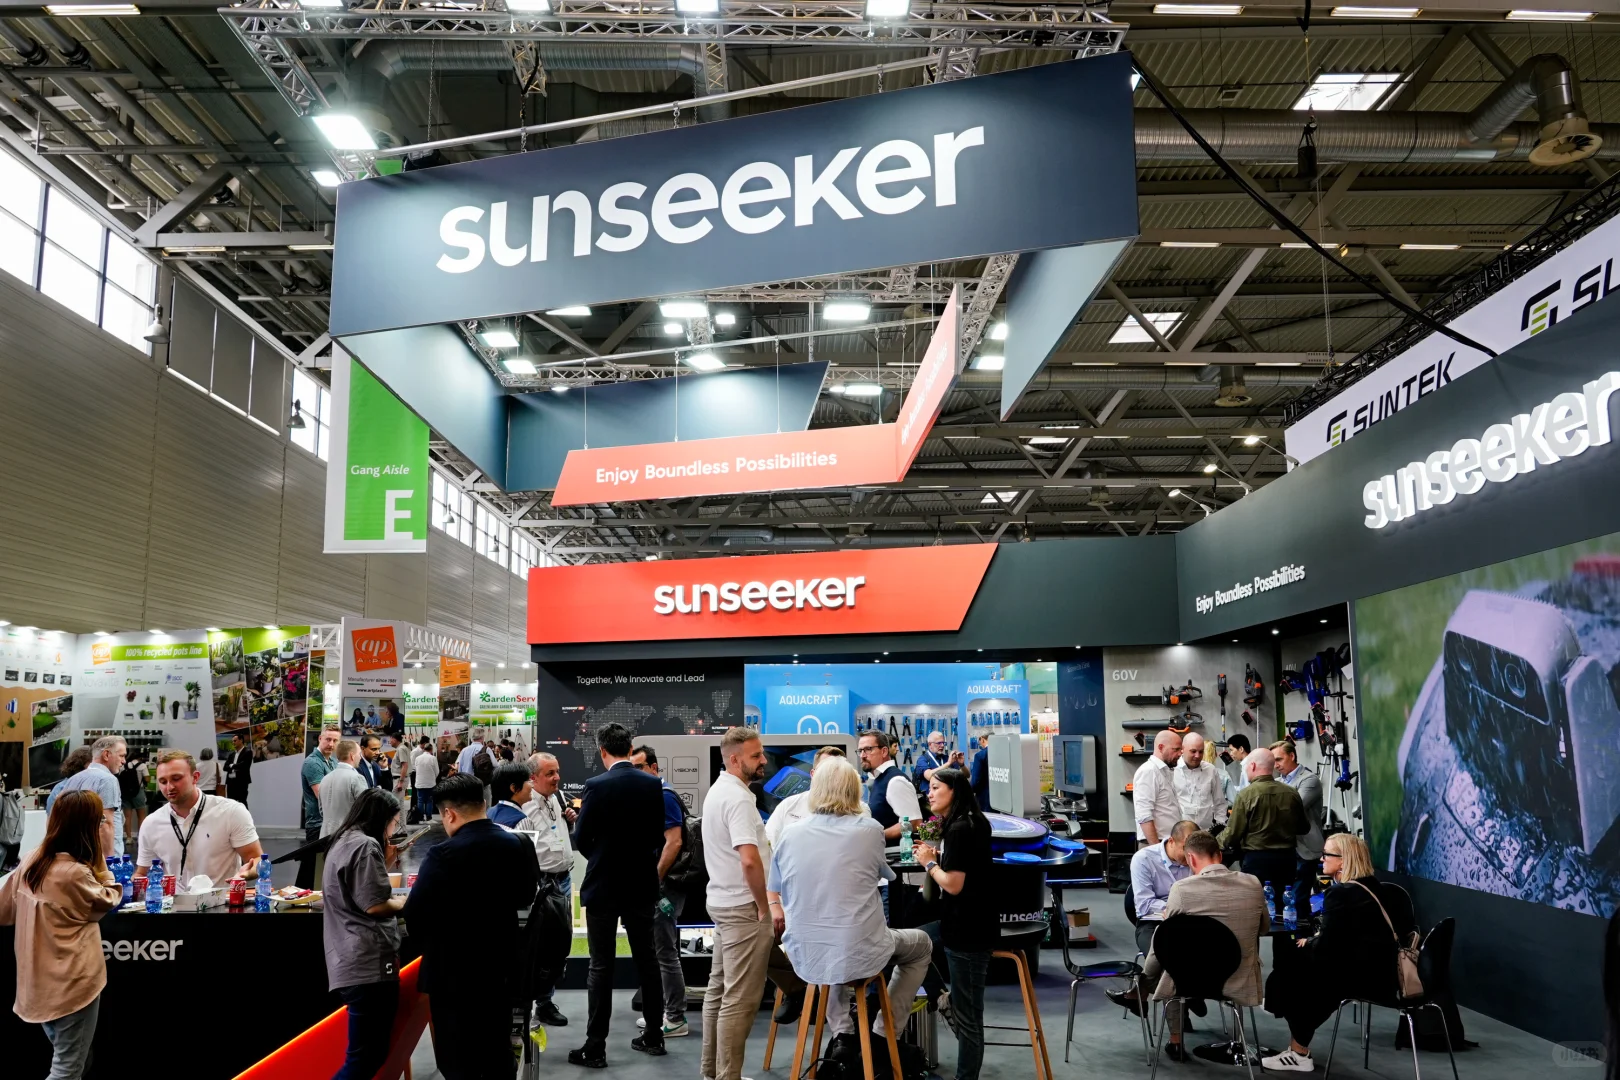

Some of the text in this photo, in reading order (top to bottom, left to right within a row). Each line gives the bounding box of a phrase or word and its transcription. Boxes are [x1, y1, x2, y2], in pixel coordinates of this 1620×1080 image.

[436, 125, 985, 274] sunseeker
[1353, 351, 1456, 437] SUNTEK
[596, 451, 838, 486] Enjoy Boundless Possibilities
[1362, 371, 1620, 529] sunseeker
[350, 464, 410, 478] Gang Aisle
[384, 490, 414, 540] E
[652, 575, 866, 616] sunseeker
[1196, 563, 1306, 615] Enjoy Boundless Possibilities
[125, 645, 203, 659] 100% recycled pots line
[576, 674, 705, 685] Together, We Innovate and Lead
[1112, 669, 1138, 681] 60V
